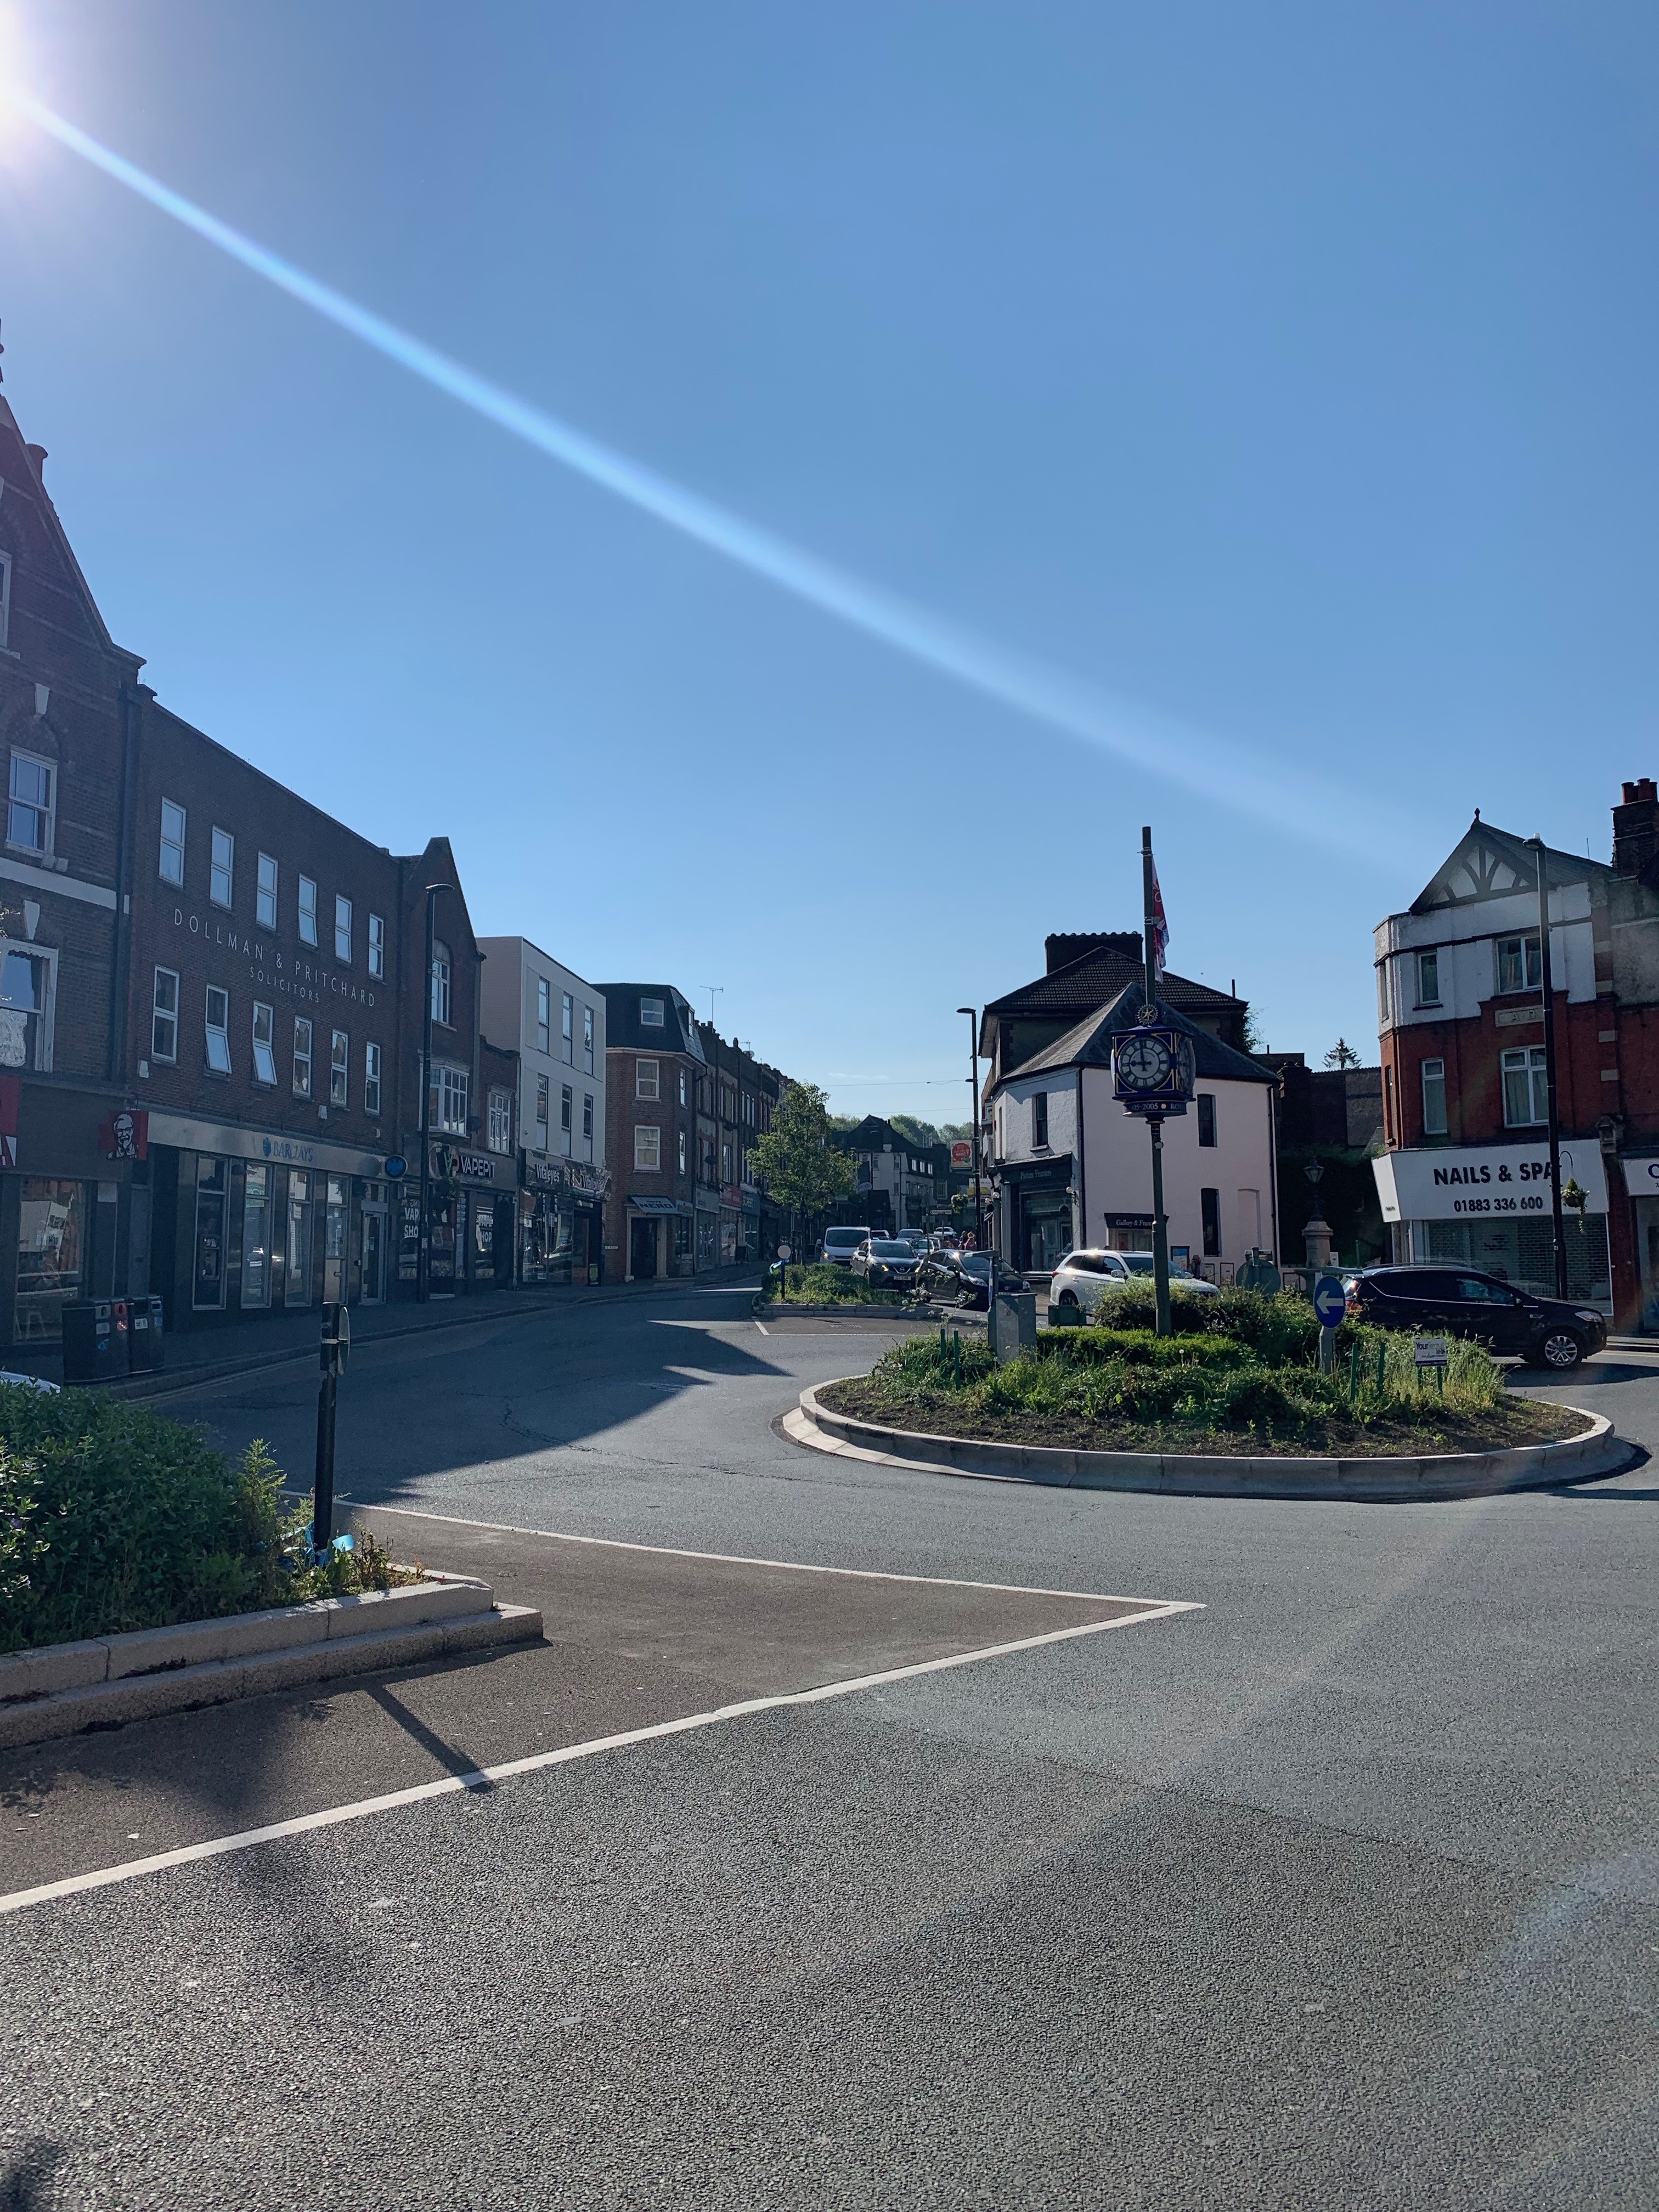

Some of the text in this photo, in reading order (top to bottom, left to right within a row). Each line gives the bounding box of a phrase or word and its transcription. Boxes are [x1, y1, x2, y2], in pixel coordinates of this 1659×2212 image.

[174, 909, 374, 1007] DOLLMAN & PRITCHARD
[250, 967, 319, 1003] SOLICITORS
[461, 1155, 496, 1180] VAPEPIT
[1434, 1165, 1491, 1186] NAILS
[1498, 1165, 1513, 1182] &
[1454, 1197, 1543, 1212] 01883 336 600
[404, 1207, 419, 1221] VAP
[1116, 1219, 1133, 1227] Gallery
[404, 1224, 419, 1238] SHO
